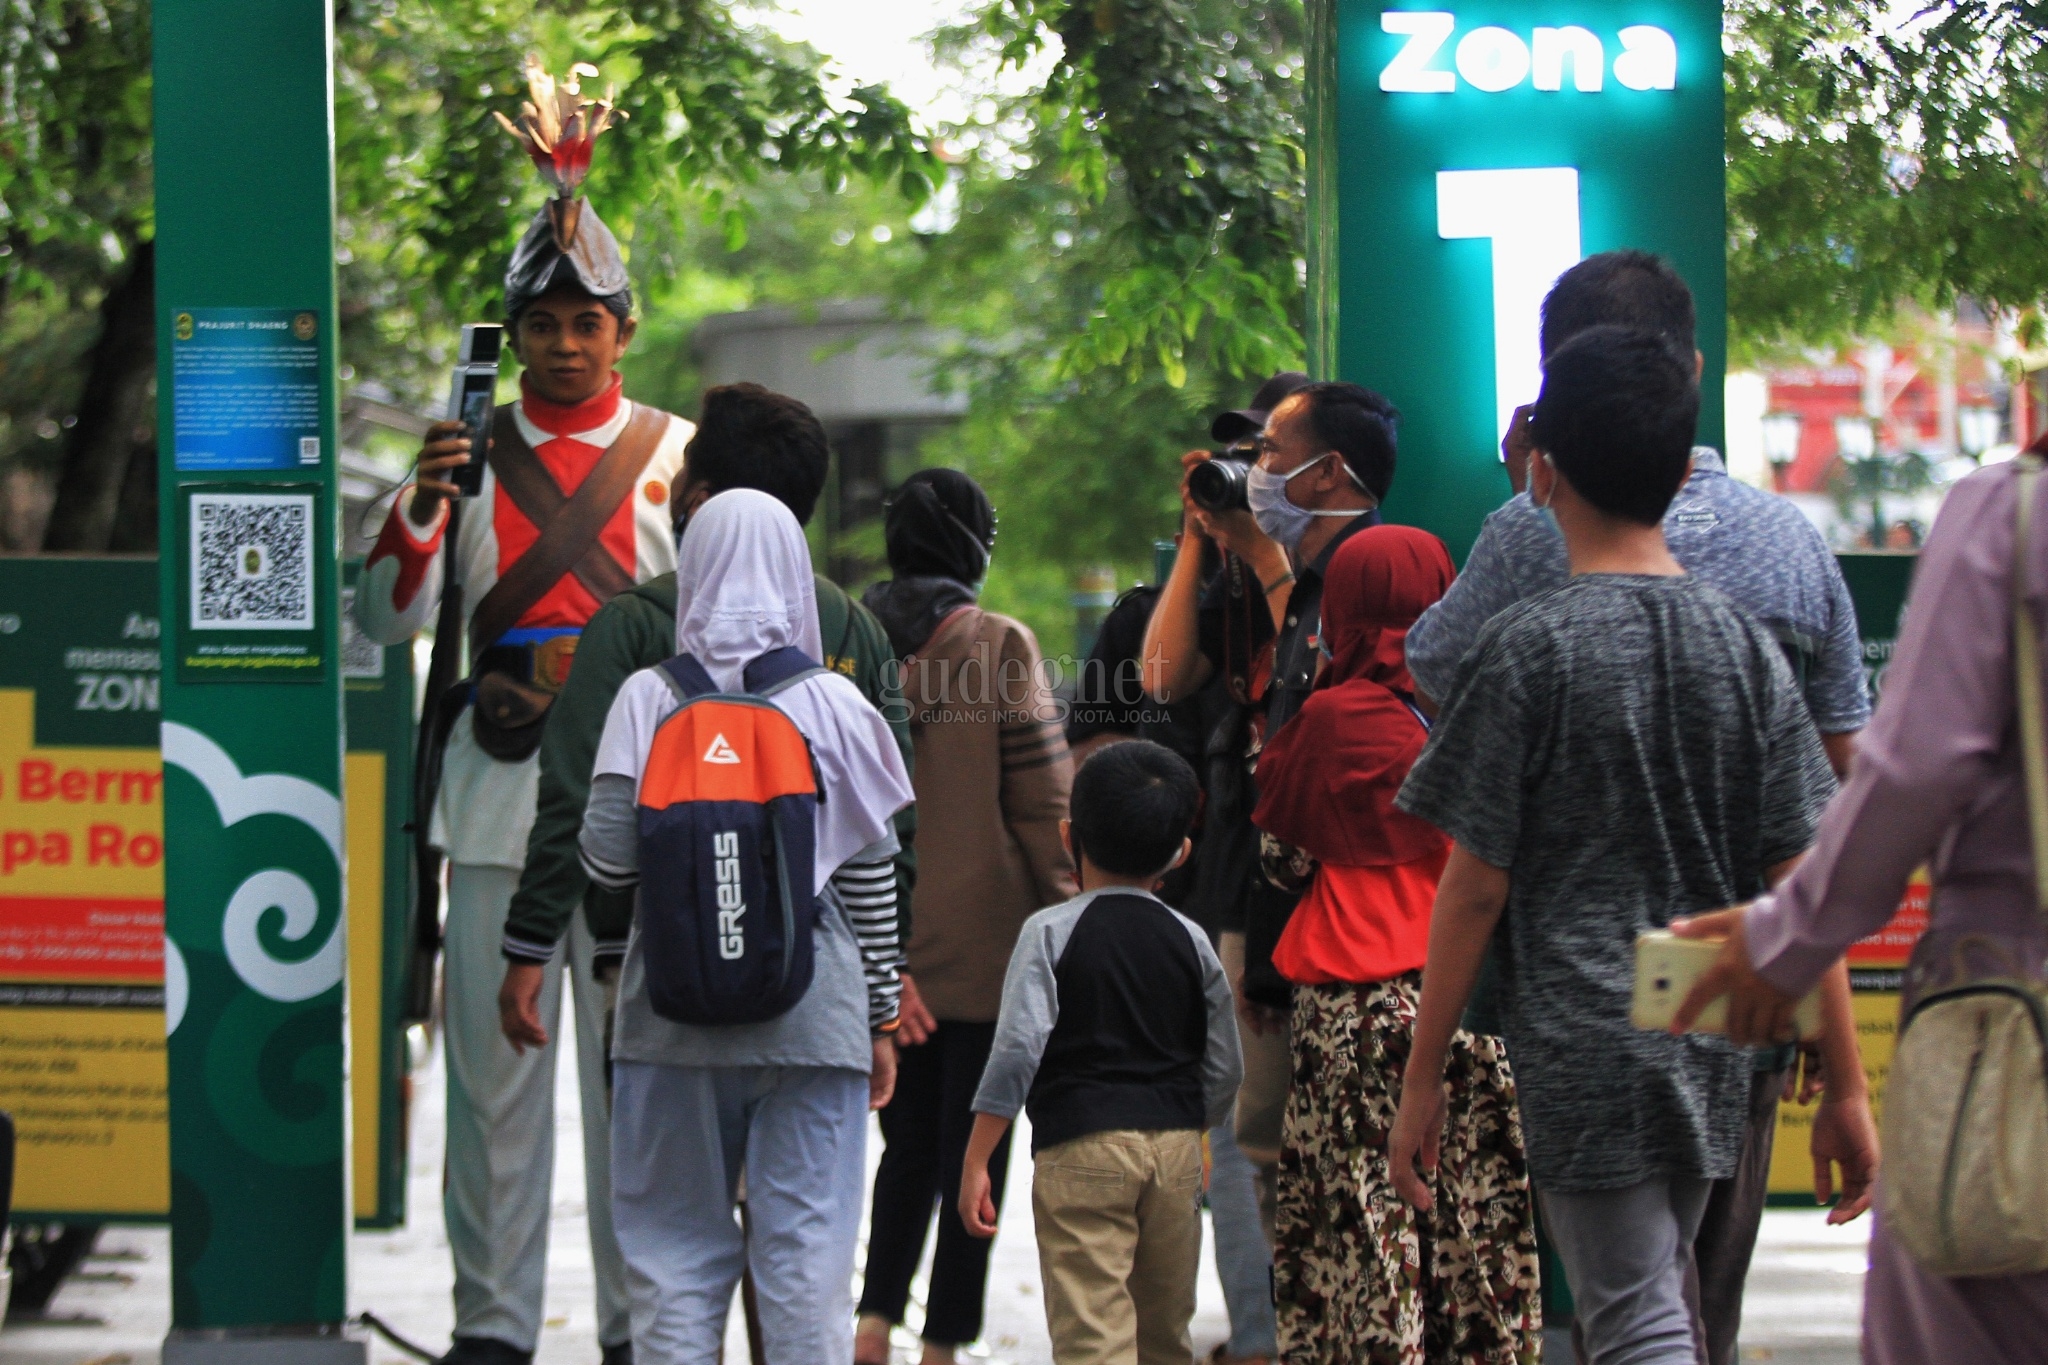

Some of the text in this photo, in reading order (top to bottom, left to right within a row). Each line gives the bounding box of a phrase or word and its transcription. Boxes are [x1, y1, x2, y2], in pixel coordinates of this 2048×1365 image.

[1379, 11, 1677, 92] Zona
[1436, 166, 1580, 463] 1
[75, 673, 160, 712] ZON
